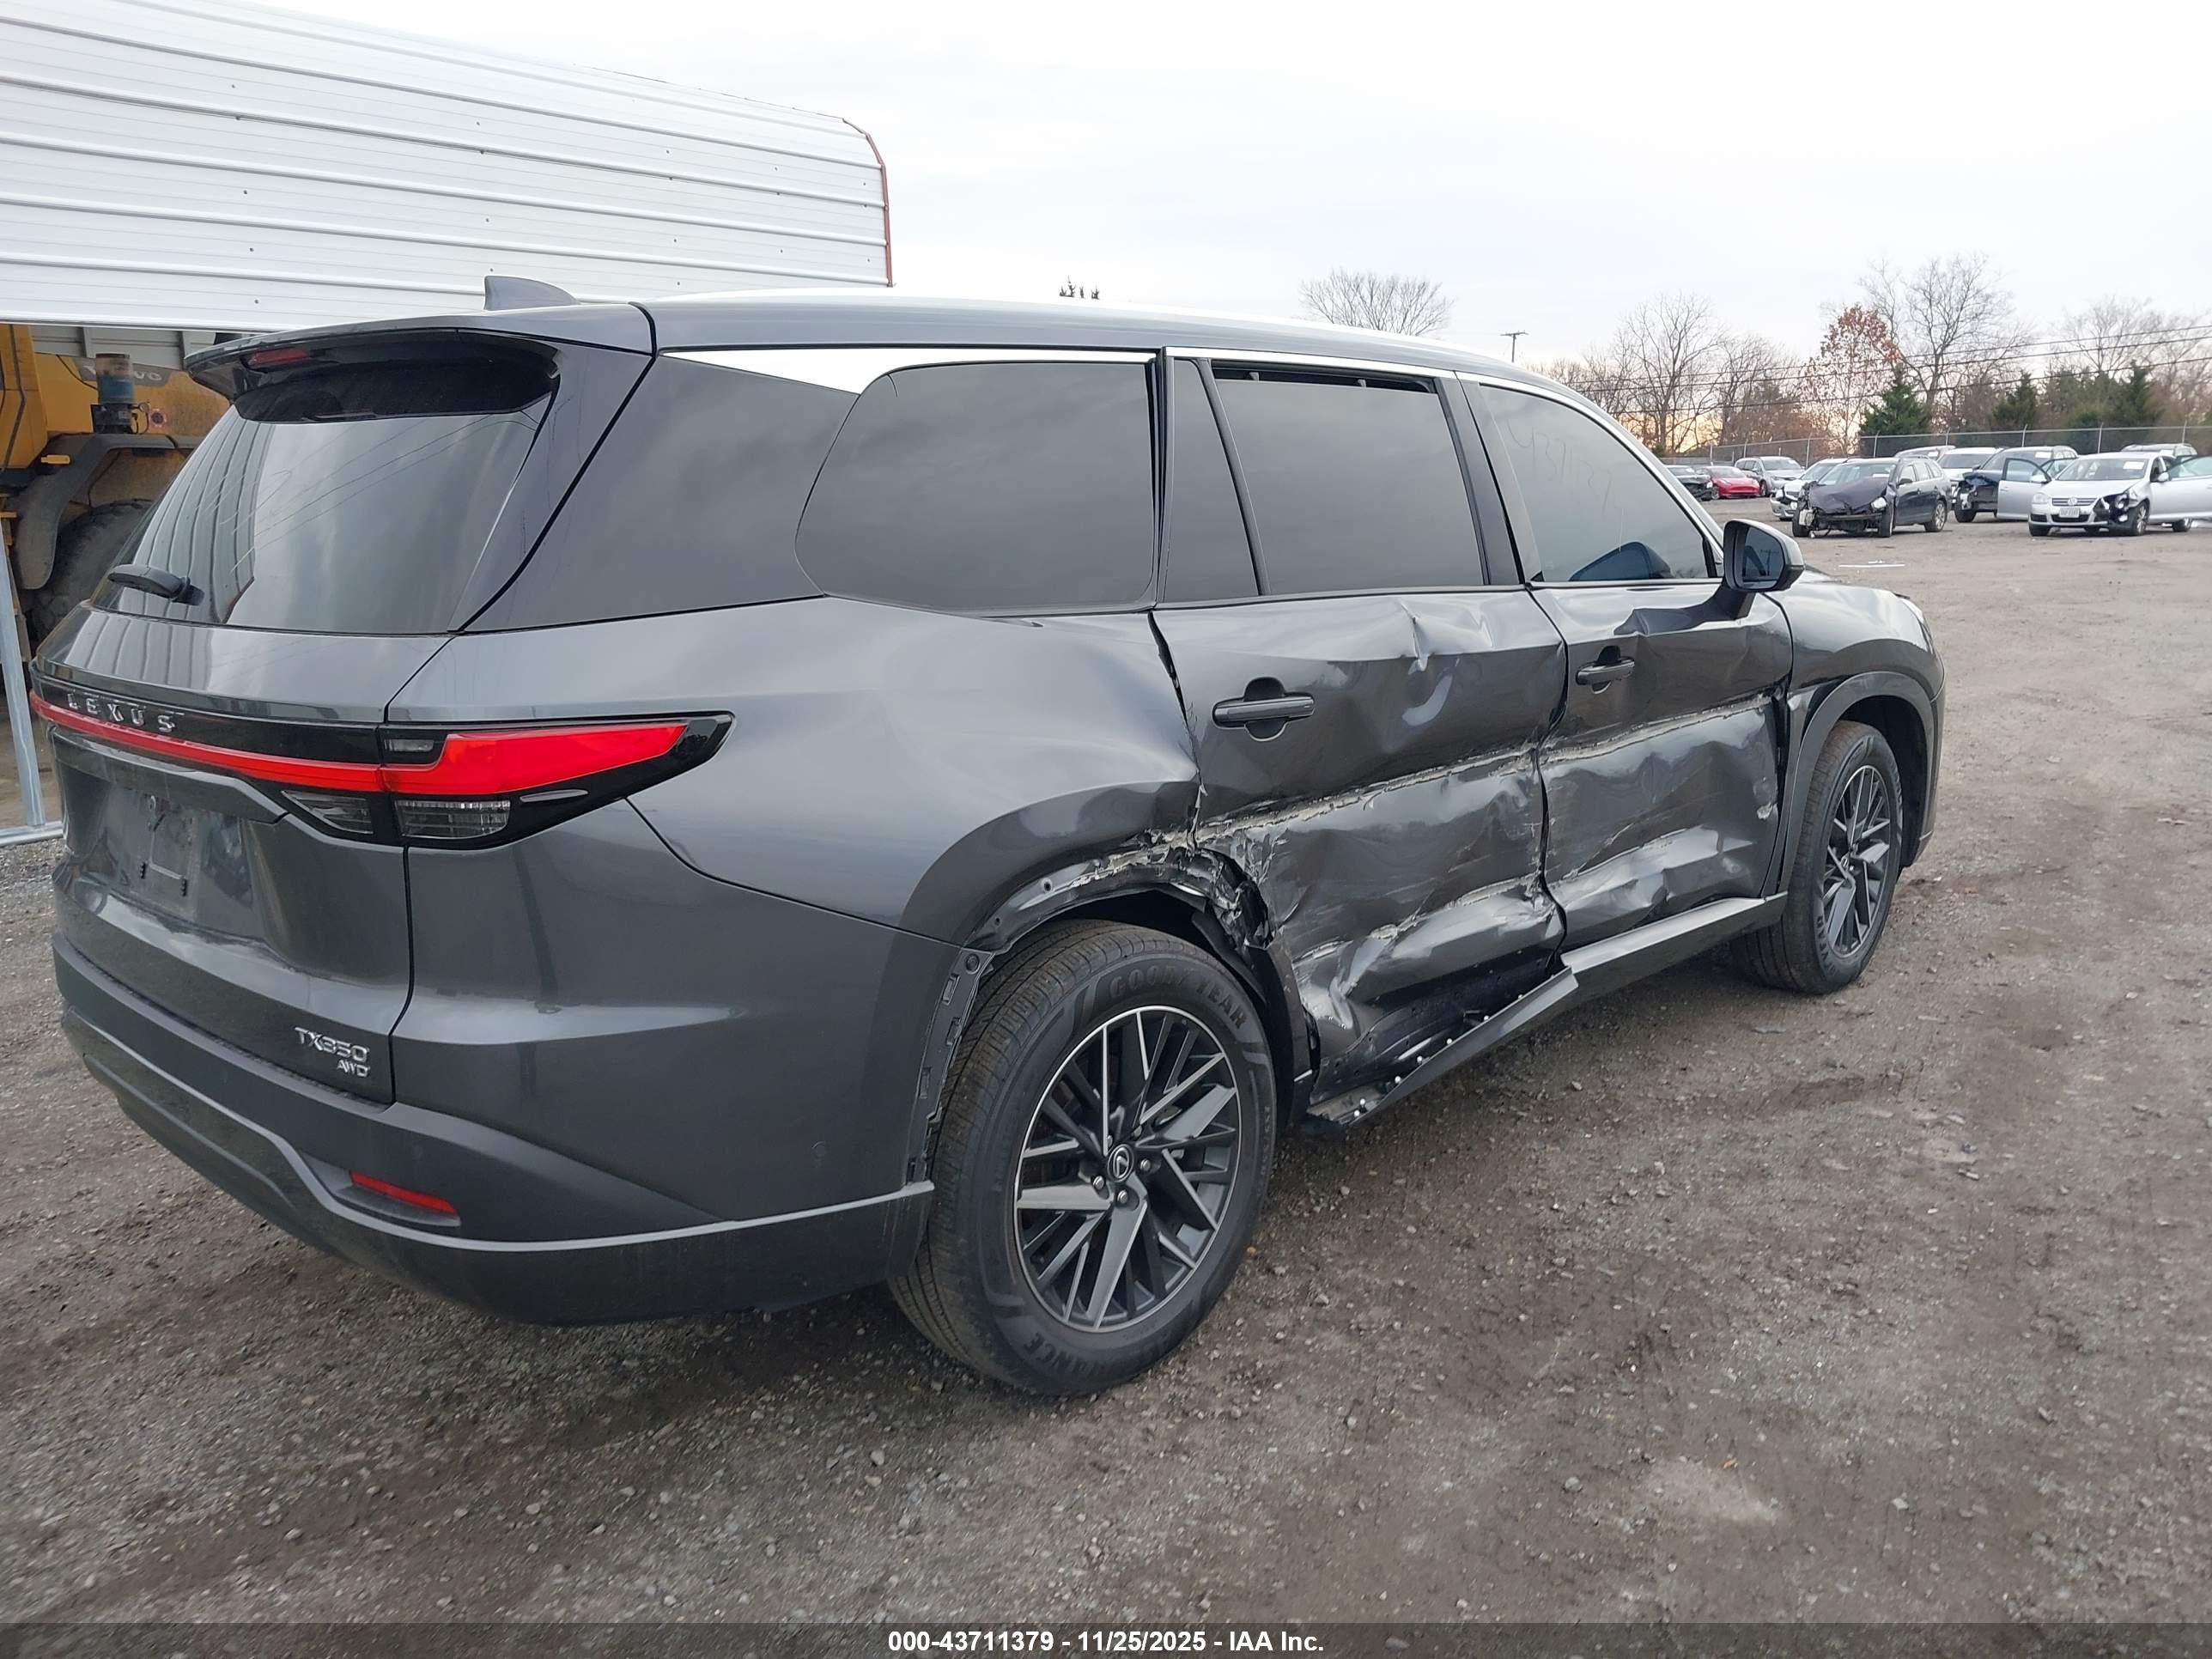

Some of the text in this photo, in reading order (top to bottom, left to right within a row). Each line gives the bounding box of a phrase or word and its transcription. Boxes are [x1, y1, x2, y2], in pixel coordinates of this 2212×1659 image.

[67, 693, 176, 733] LEXUS
[294, 1026, 370, 1062] TX350
[336, 1059, 370, 1078] AWD
